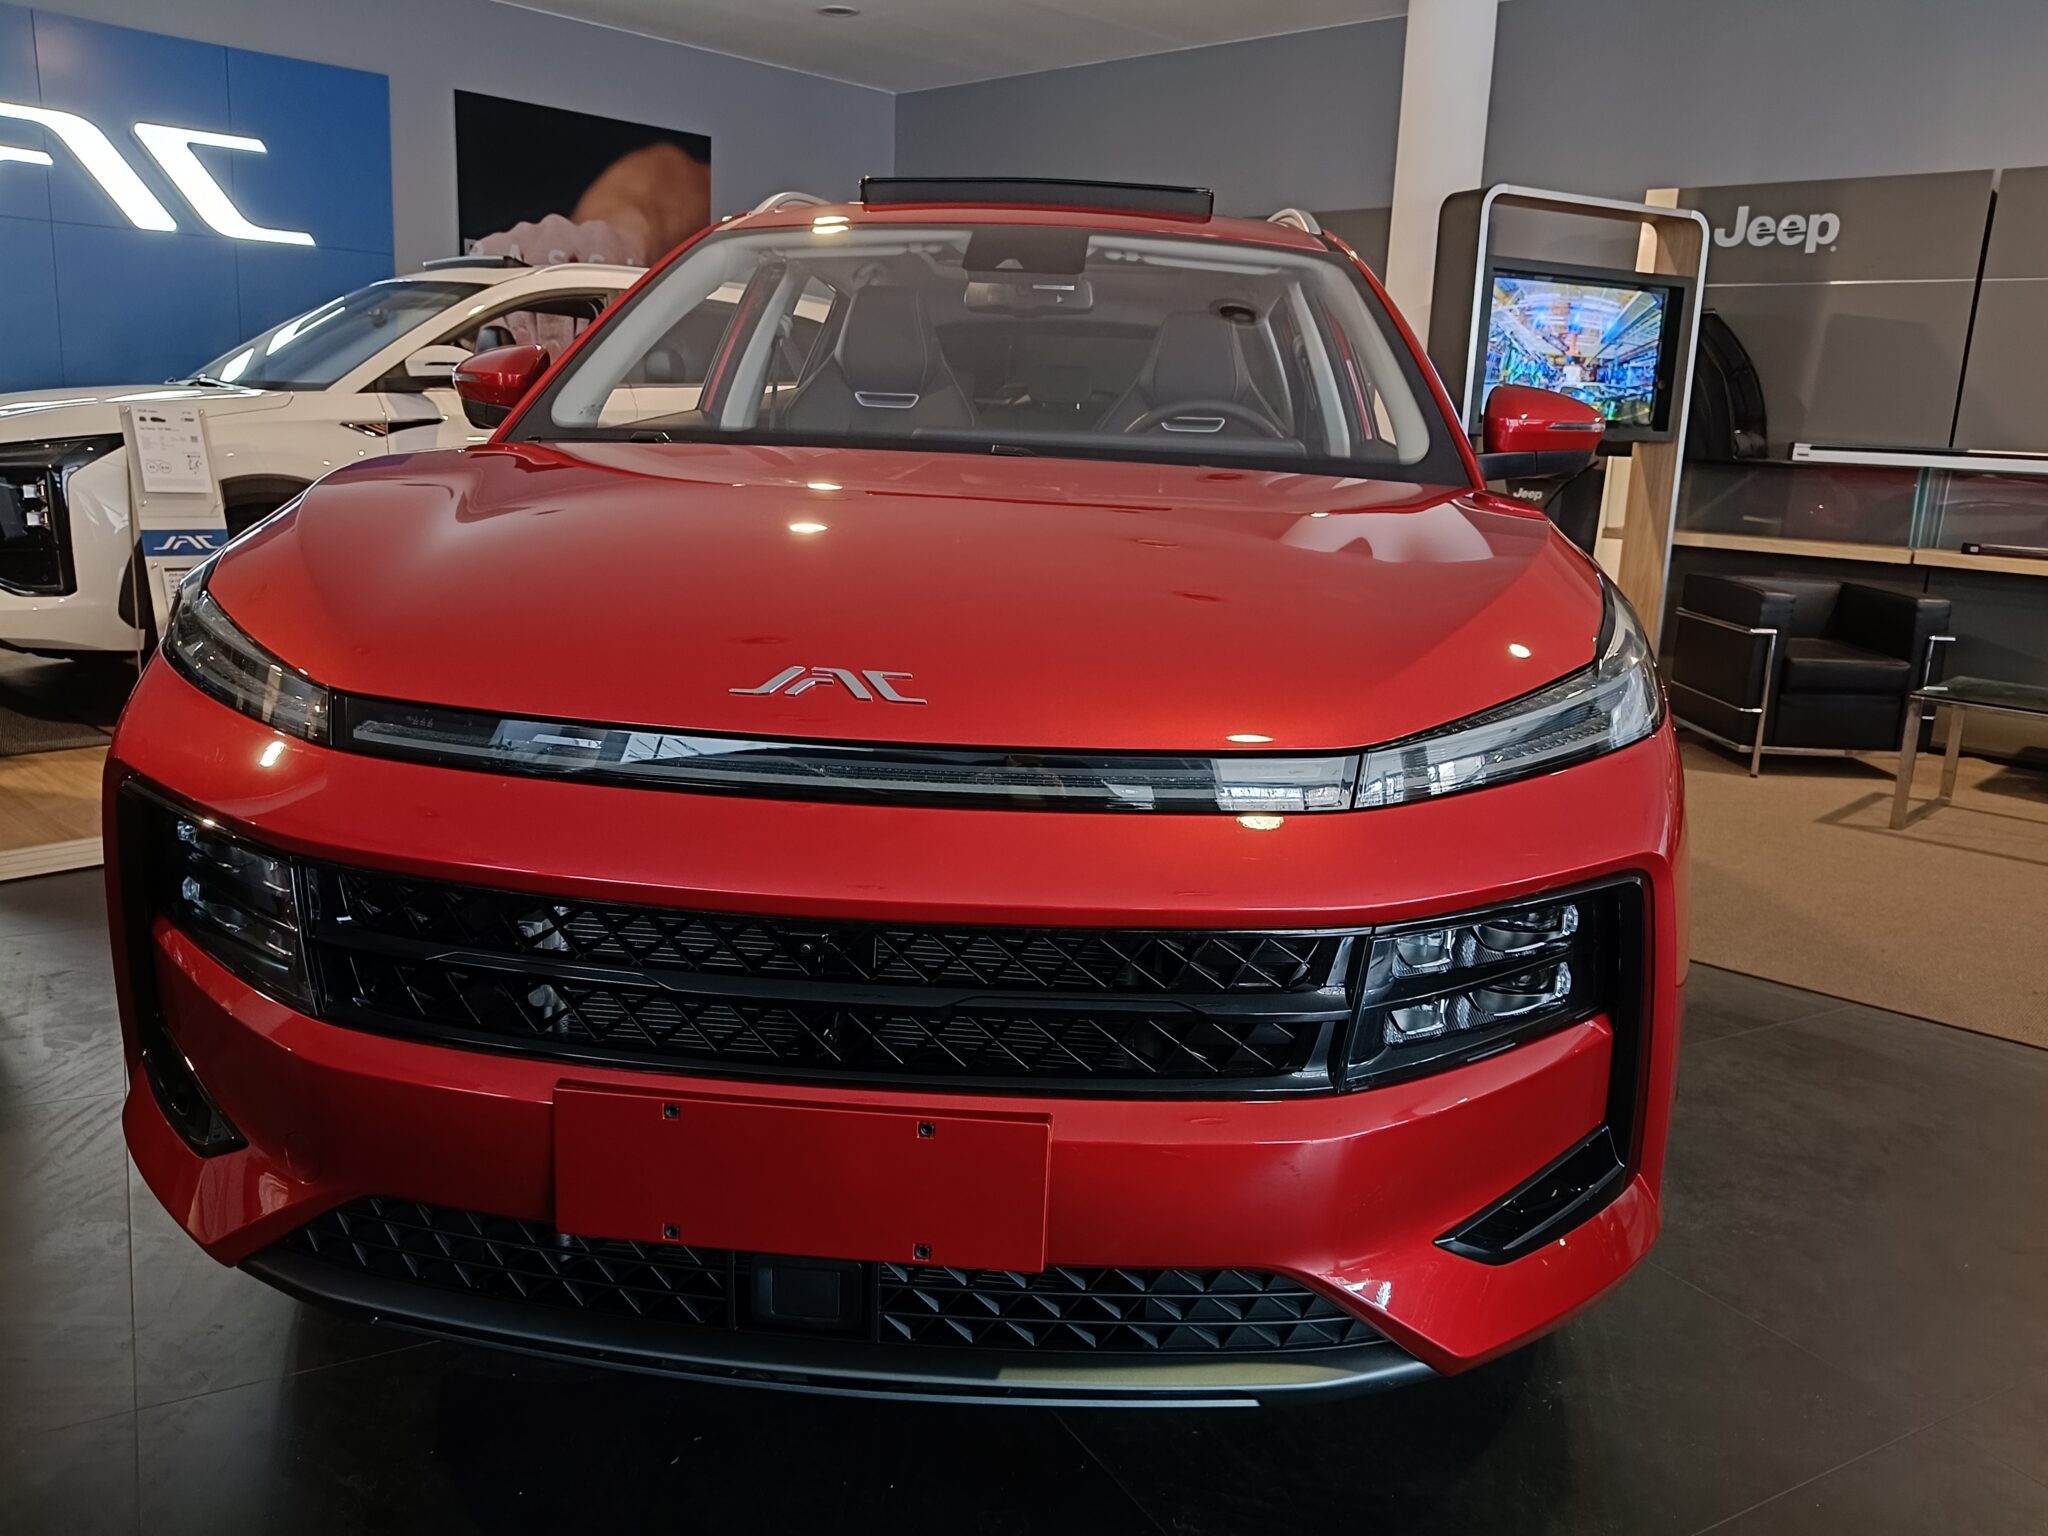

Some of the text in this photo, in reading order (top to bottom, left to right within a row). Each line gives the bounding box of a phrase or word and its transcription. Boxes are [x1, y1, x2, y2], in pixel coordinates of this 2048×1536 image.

[0, 102, 316, 246] AC
[1714, 206, 1840, 253] Jeep
[1513, 488, 1543, 501] Jeep
[153, 535, 222, 550] JAC
[728, 666, 928, 705] JAC
